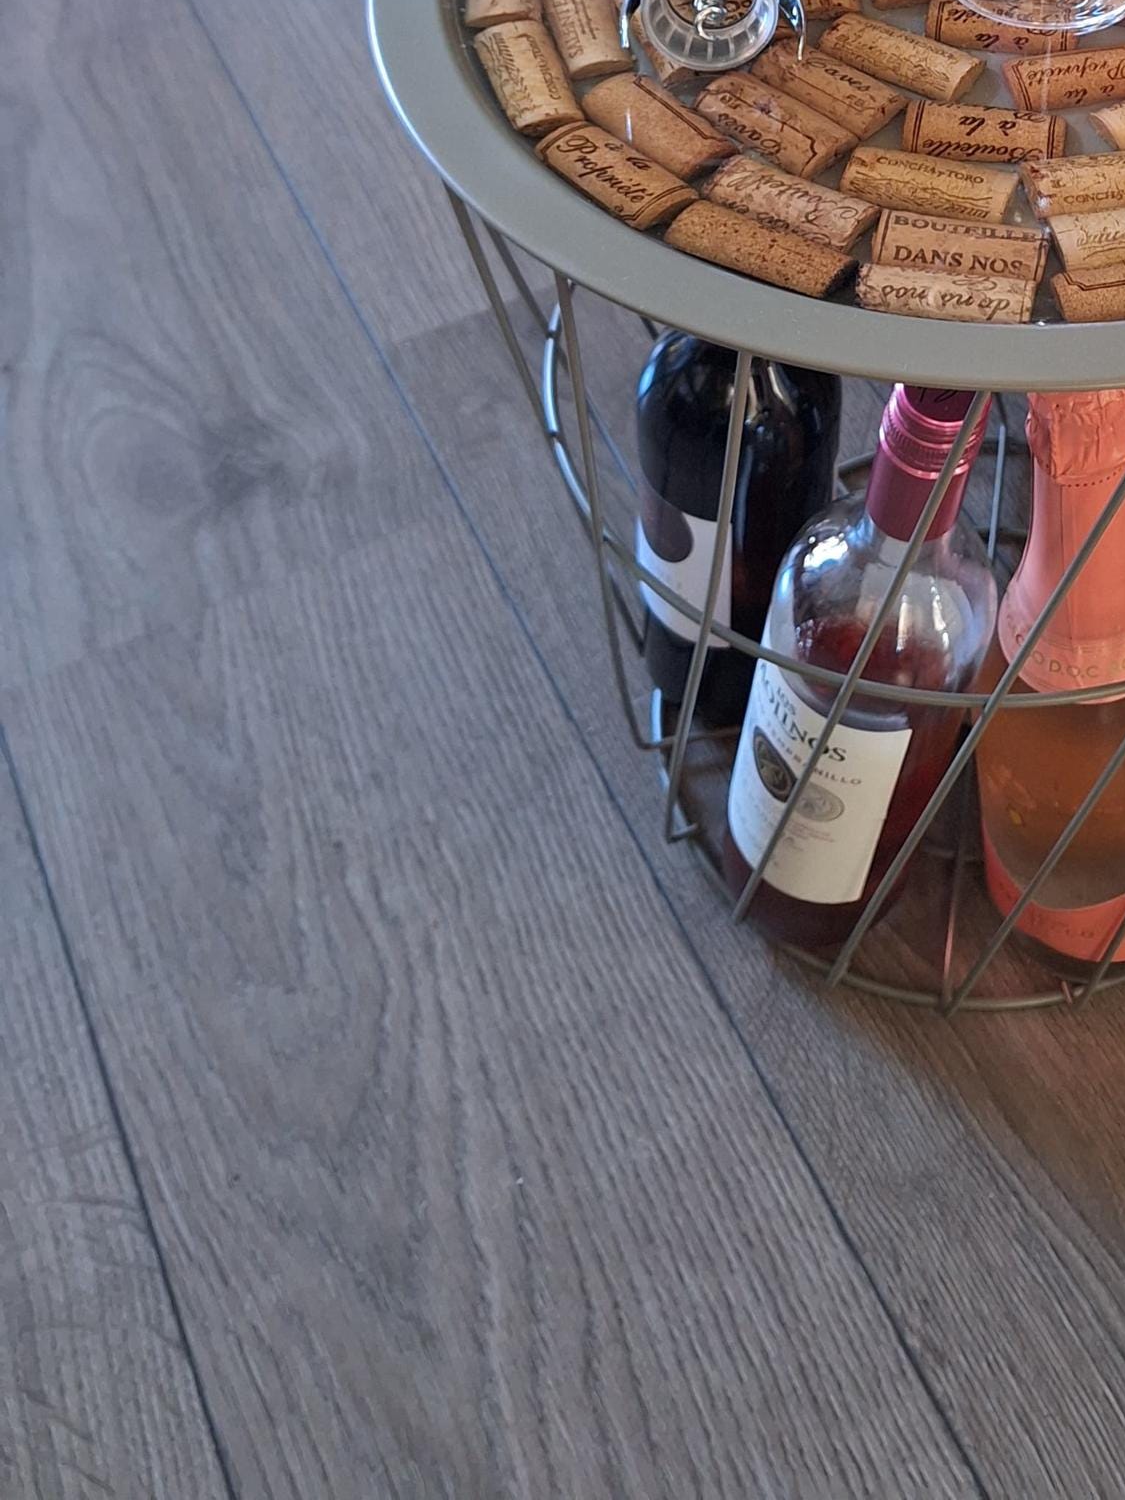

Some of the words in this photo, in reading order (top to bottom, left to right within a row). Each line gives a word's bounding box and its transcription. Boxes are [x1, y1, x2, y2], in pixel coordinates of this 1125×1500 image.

[975, 31, 999, 49] la
[959, 115, 986, 137] la
[998, 120, 1017, 137] à
[556, 133, 656, 205] Propriété
[625, 155, 653, 172] la
[876, 155, 937, 177] CONCHA
[944, 168, 985, 185] TORO
[893, 245, 964, 268] DANS
[968, 255, 1025, 276] NOS
